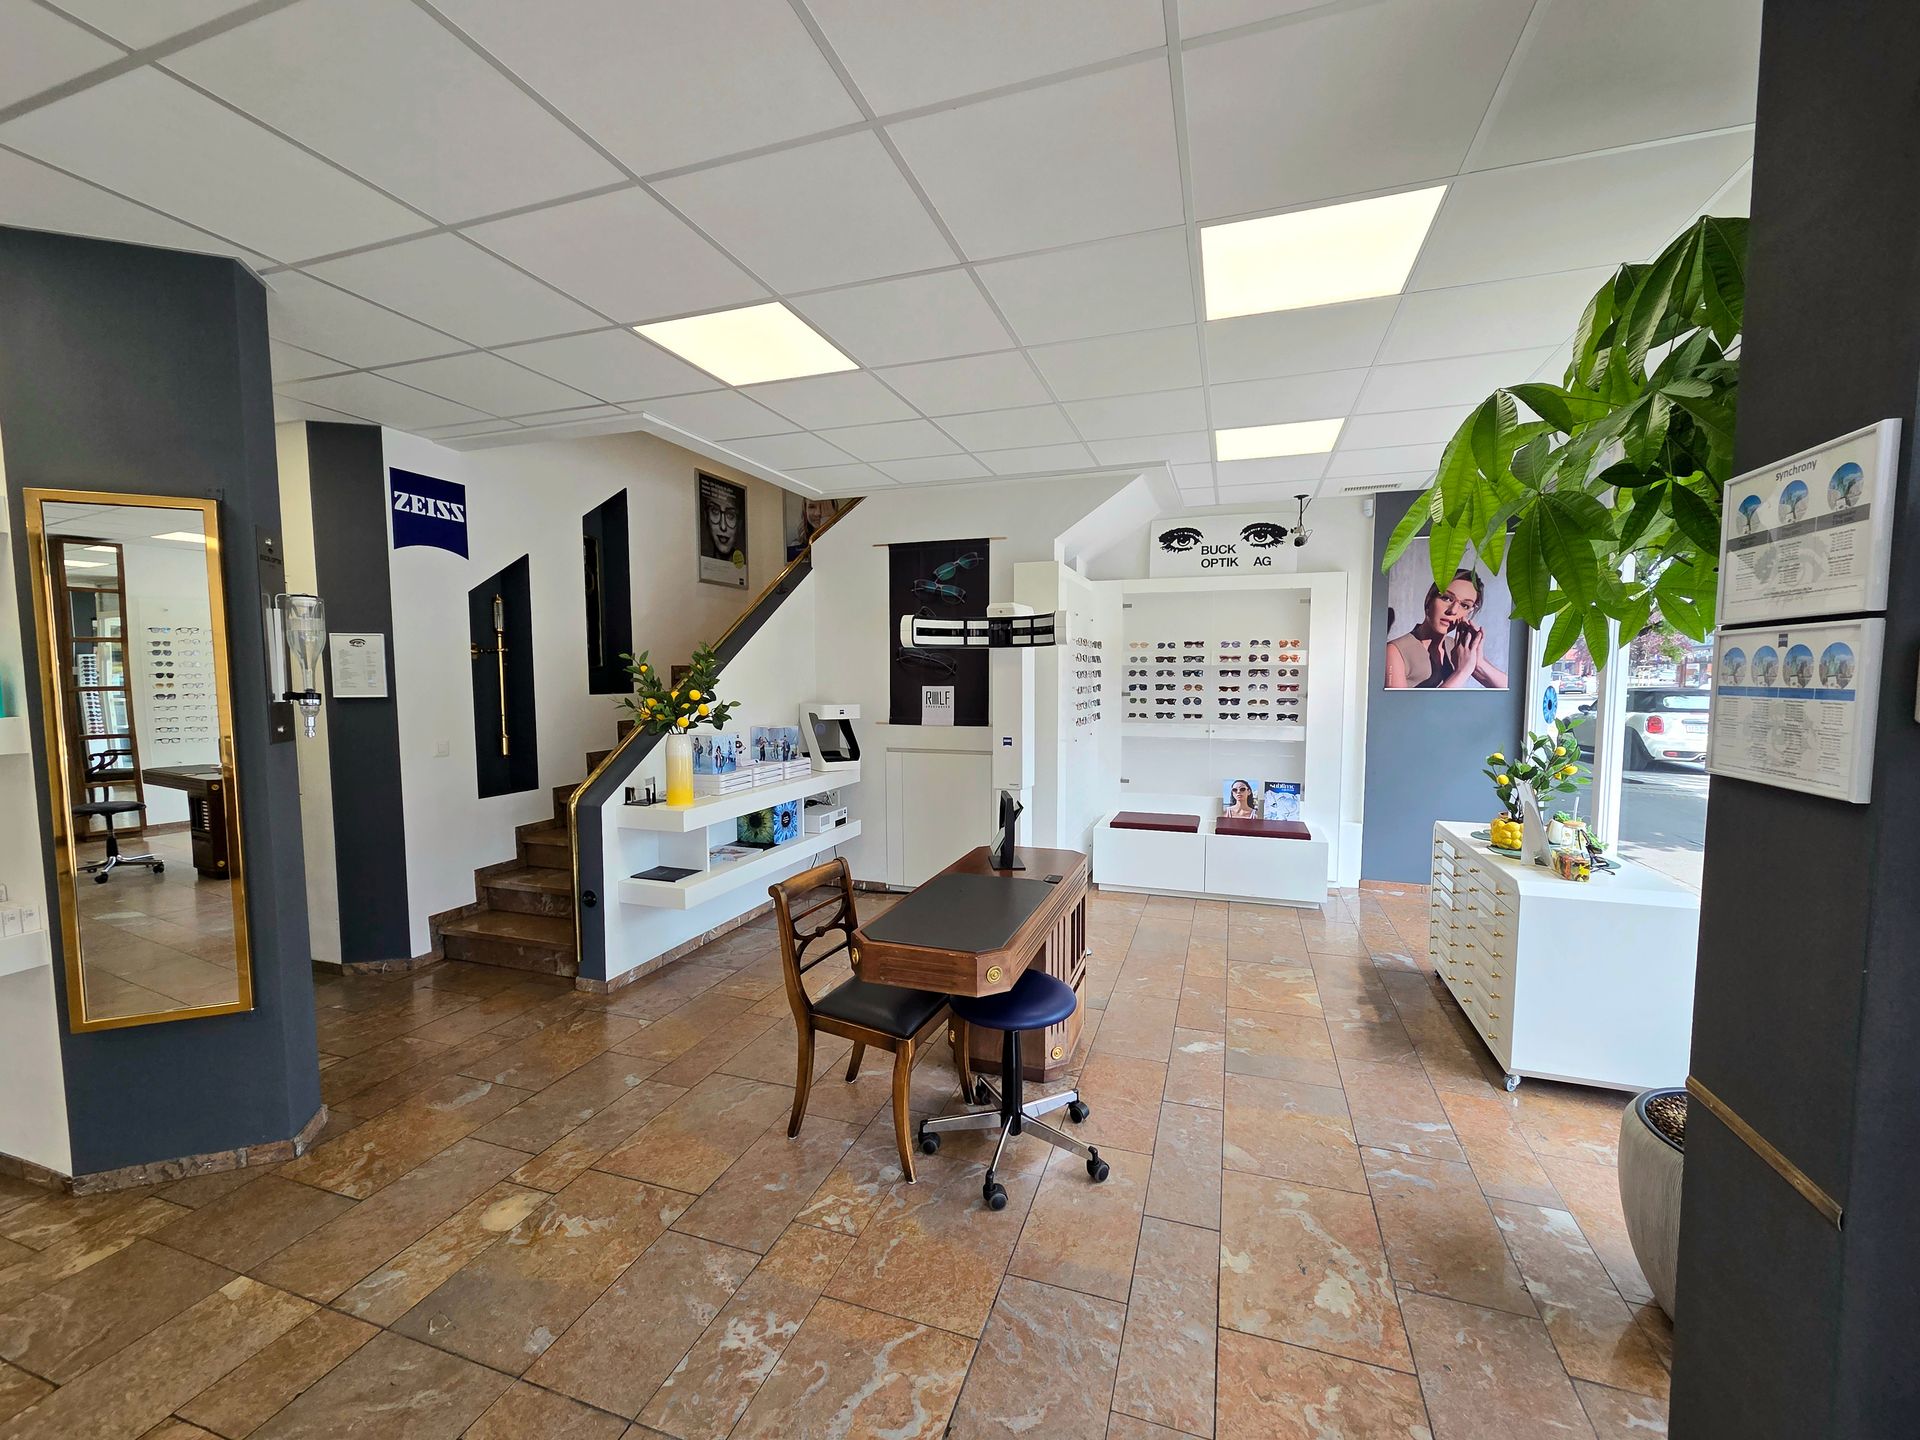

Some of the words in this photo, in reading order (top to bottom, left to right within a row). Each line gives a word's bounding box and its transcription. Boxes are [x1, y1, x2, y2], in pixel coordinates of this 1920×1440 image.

[1775, 460, 1817, 481] synchrony
[393, 490, 465, 523] ZEISS
[1201, 544, 1236, 555] BUCK
[1201, 557, 1239, 568] OPTIK
[1253, 556, 1271, 566] AG
